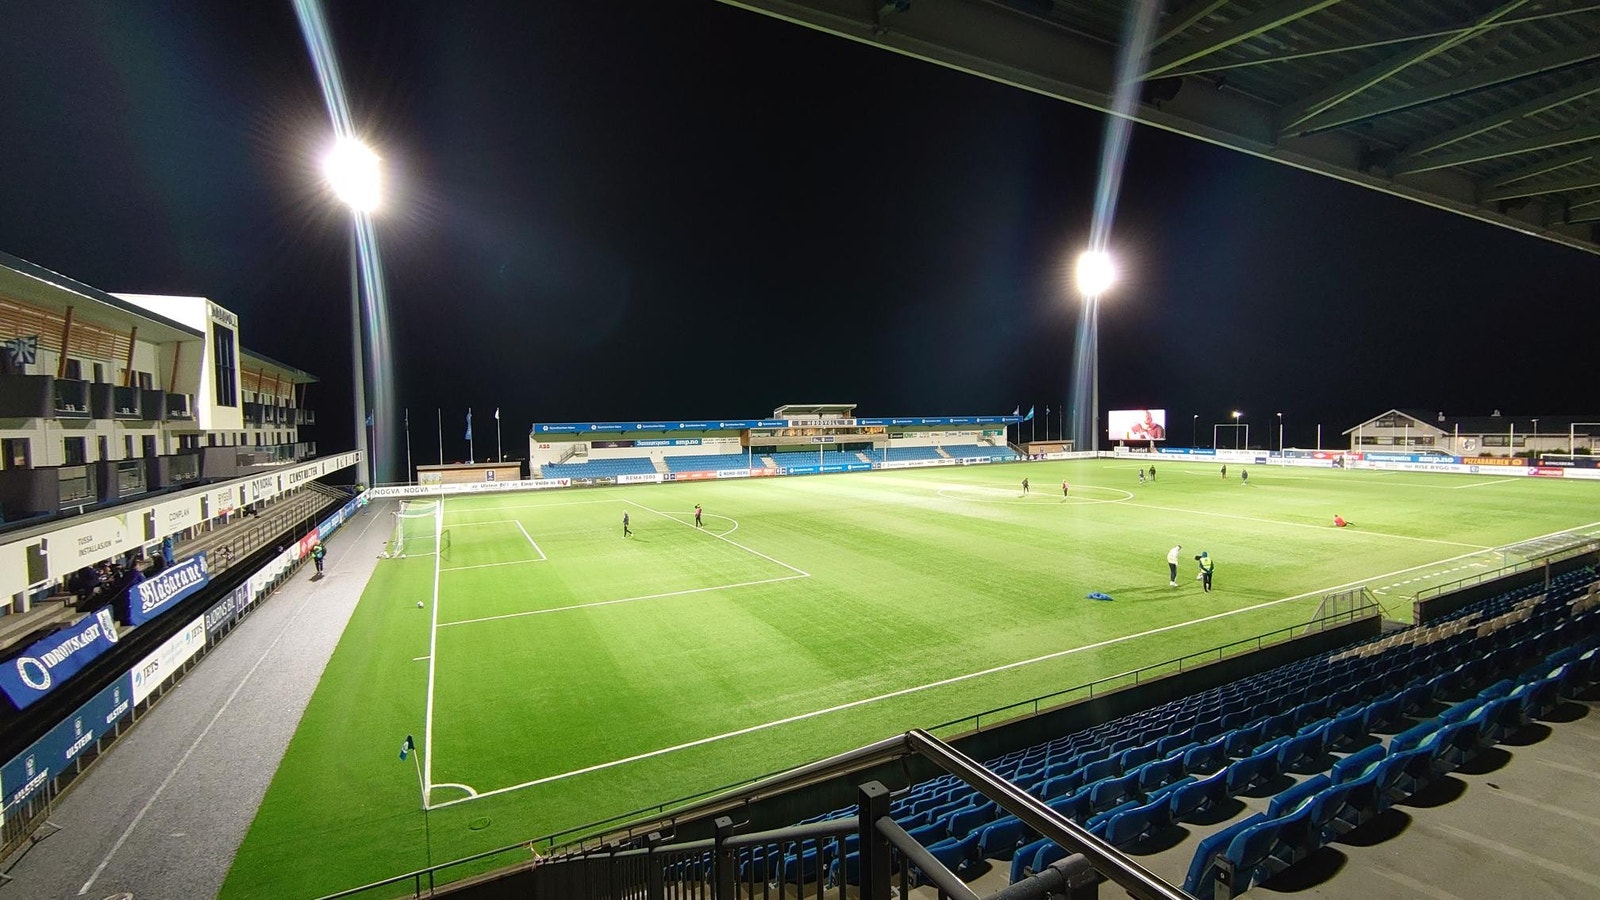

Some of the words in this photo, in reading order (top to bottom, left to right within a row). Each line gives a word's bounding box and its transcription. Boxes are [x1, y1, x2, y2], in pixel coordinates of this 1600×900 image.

[374, 488, 400, 496] NOGVA
[404, 487, 430, 495] NOGVA
[78, 536, 93, 546] TUSSA
[143, 658, 159, 685] JETS
[106, 699, 129, 724] ULSTEIN
[66, 729, 94, 759] ULSTEIN
